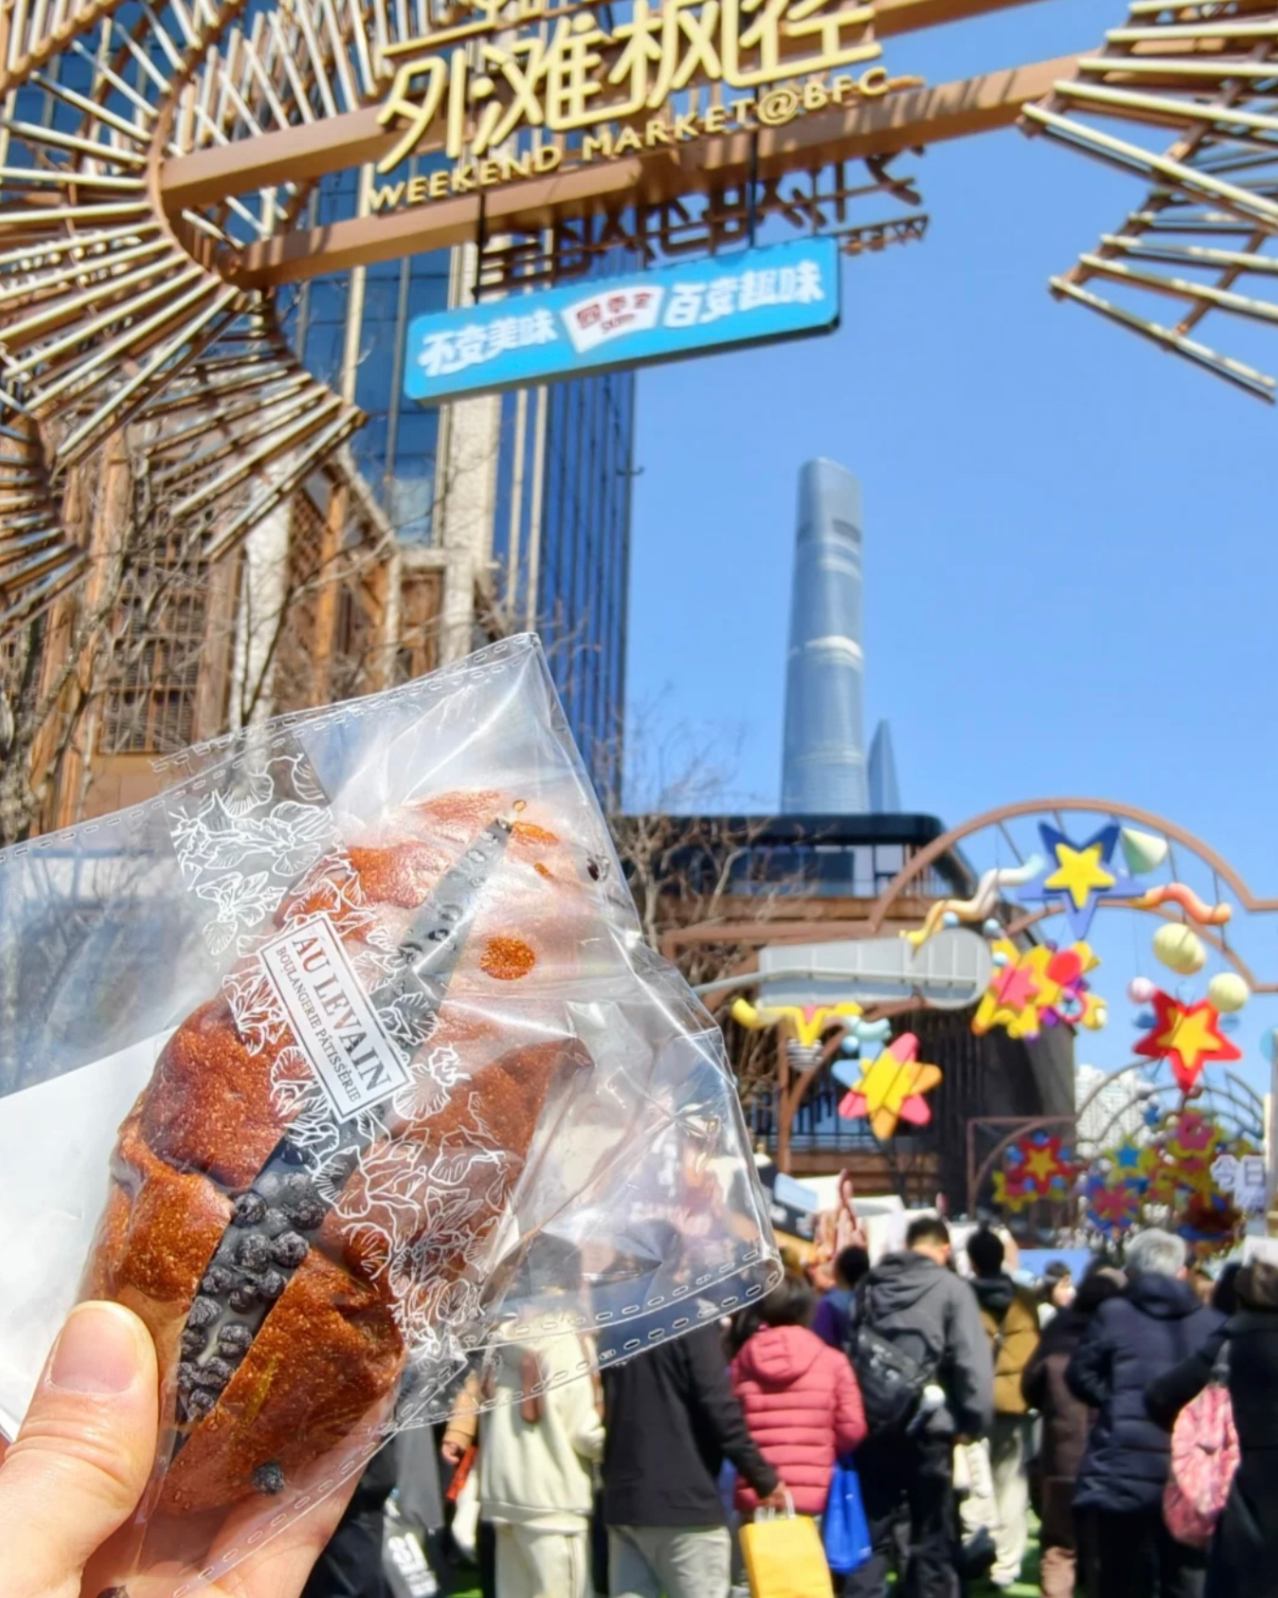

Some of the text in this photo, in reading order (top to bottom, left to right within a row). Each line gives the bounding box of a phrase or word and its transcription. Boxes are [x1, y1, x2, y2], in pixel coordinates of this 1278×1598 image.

[367, 66, 889, 209] WEEKEND MARKET@BFC
[375, 0, 883, 173] 外滩枫径
[664, 260, 826, 330] 百变趣味
[275, 946, 322, 1031] BOULANGERIE
[292, 936, 392, 1092] AU LEVAIN
